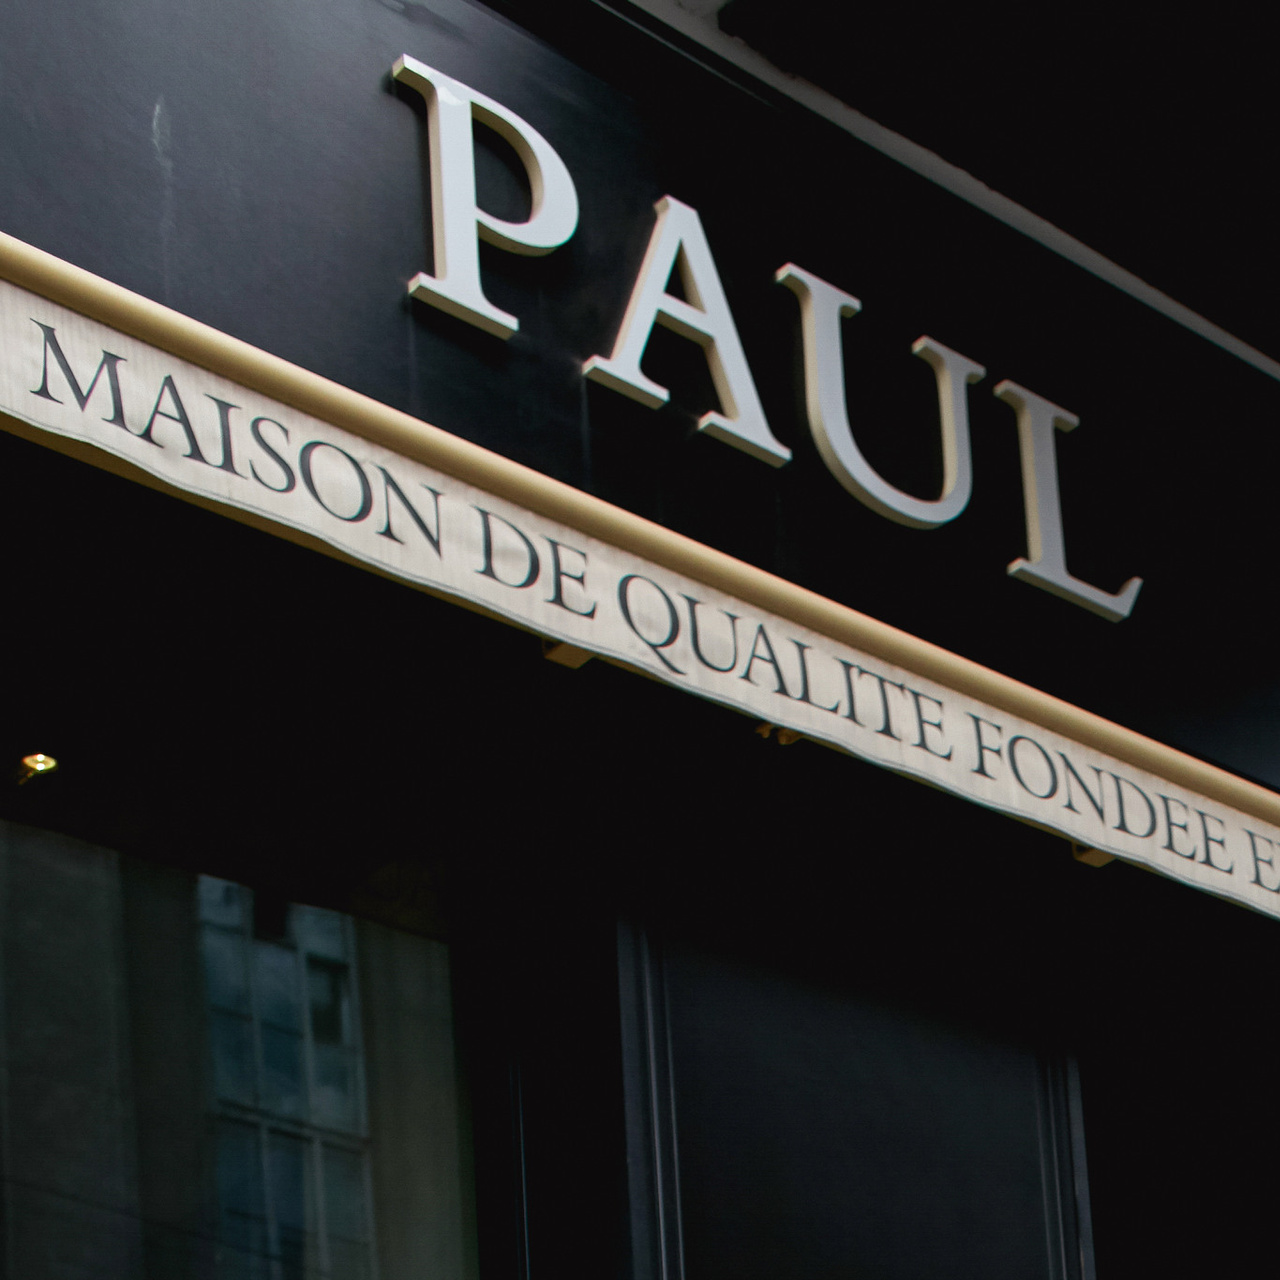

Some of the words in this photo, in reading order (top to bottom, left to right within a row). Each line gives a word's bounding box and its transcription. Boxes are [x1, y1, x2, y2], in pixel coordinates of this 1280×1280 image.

[29, 318, 445, 560] MAISON
[472, 504, 600, 620] DE
[617, 573, 953, 761] QUALITE
[968, 712, 1234, 875] FONDEE
[391, 53, 1142, 622] PAUL
